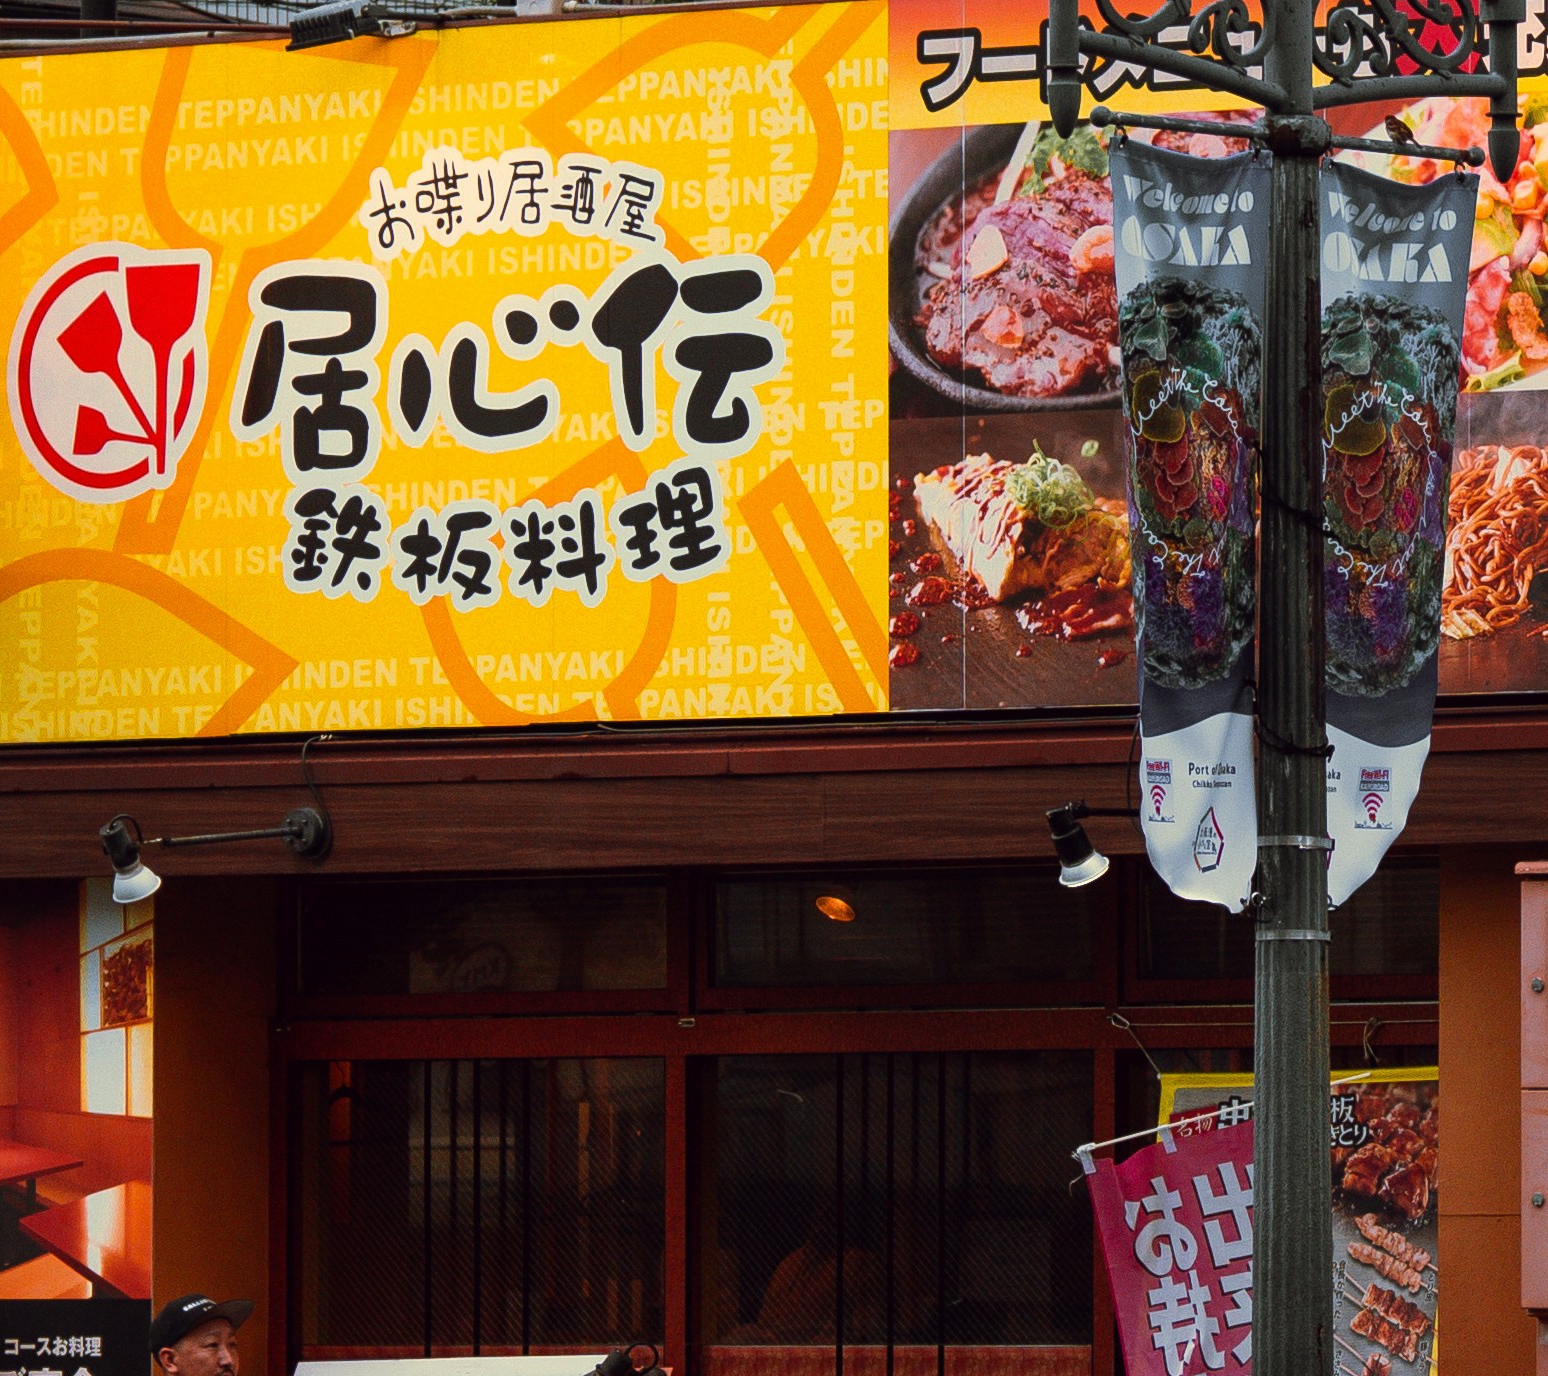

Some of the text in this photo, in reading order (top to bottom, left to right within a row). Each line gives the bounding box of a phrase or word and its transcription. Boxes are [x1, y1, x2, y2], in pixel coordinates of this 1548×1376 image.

[240, 264, 784, 472] 居心伝
[291, 465, 722, 601] 鉄板料理
[4, 1336, 102, 1358] コースお料理
